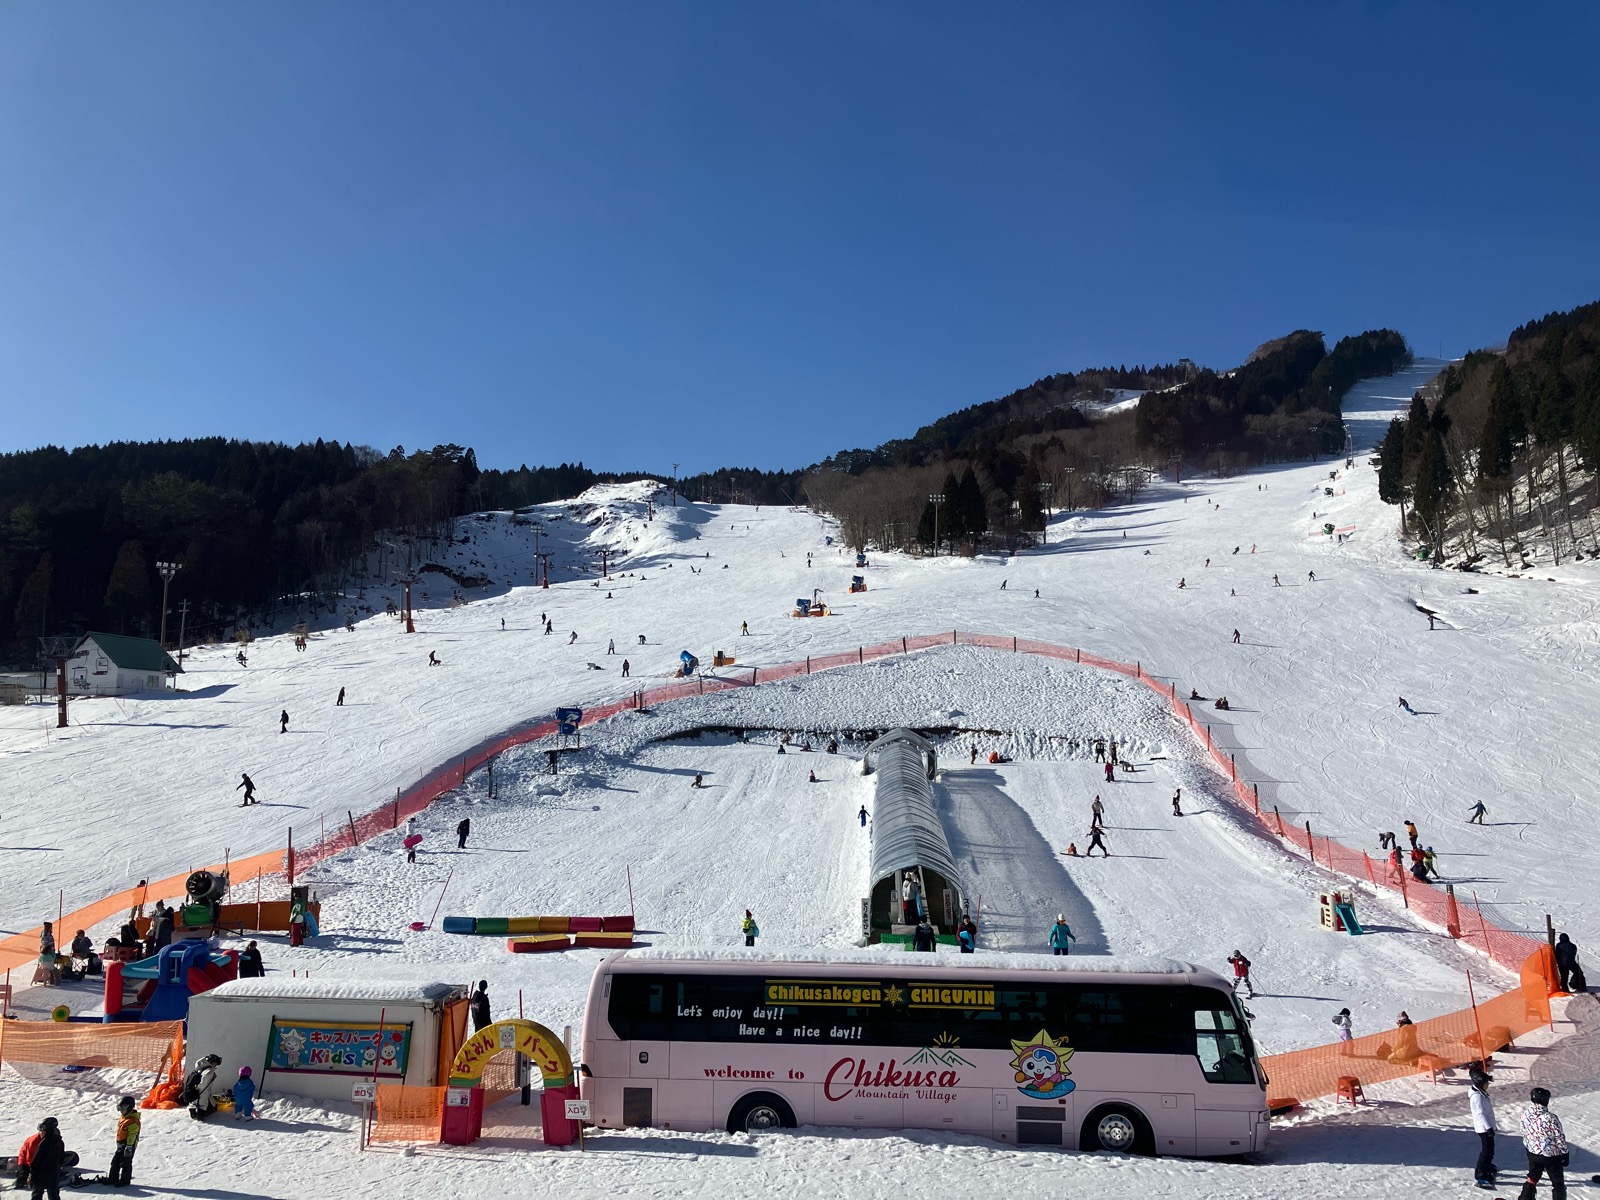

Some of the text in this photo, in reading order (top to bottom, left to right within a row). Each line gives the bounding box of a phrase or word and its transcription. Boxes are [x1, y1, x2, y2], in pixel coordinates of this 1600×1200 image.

[768, 985, 995, 1005] Chikusakogen CHIGUMIN
[677, 1005, 784, 1020] Let's enjoy day!!
[310, 1031, 383, 1046] キッズパーク
[739, 1024, 862, 1039] Have a nice day!!
[310, 1048, 355, 1065] Kids
[456, 1035, 559, 1074] ちぐみん パーク
[704, 1065, 805, 1080] welcome to
[824, 1057, 961, 1102] Chikusa
[855, 1089, 957, 1103] Mountain Village
[567, 1106, 580, 1114] 入口
